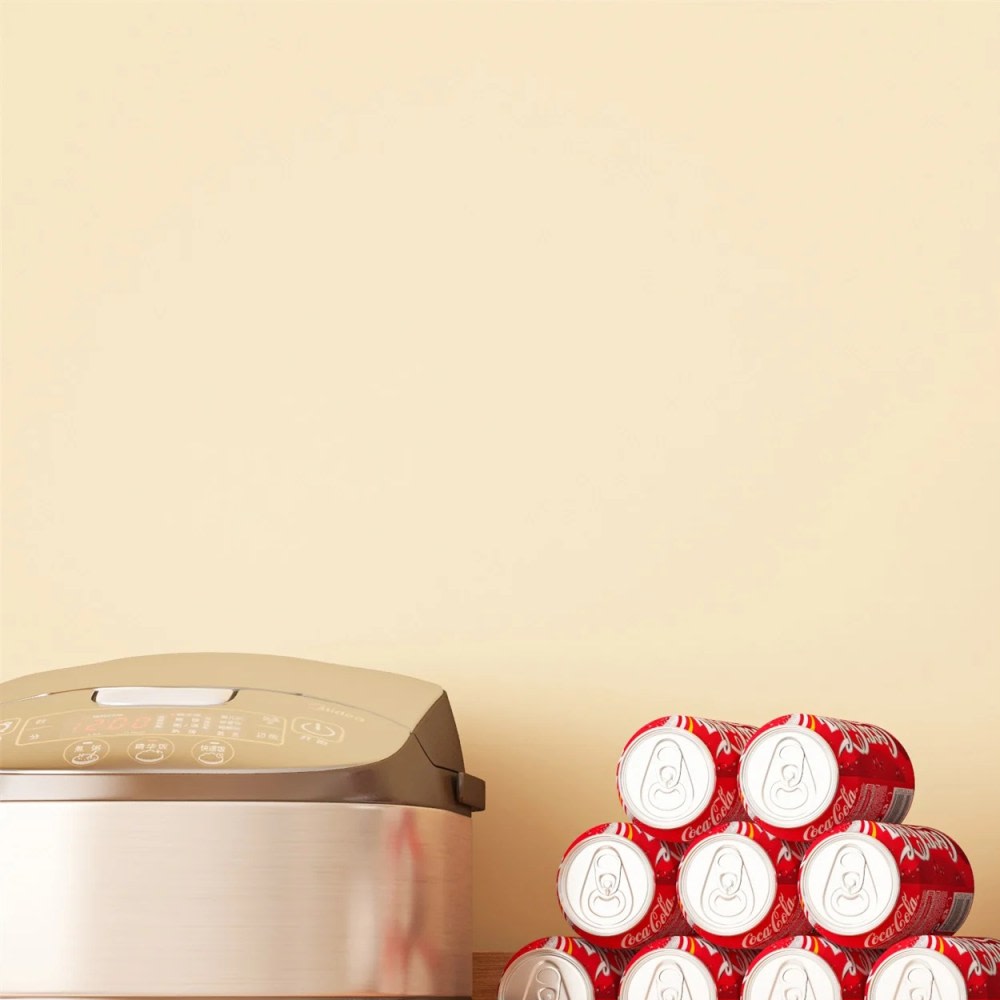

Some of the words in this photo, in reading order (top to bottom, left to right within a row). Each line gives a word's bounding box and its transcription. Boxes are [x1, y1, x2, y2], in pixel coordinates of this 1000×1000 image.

[681, 788, 736, 842] Coca-Cola
[803, 786, 858, 842] Coca-Cola
[620, 894, 675, 948] Coca-Cola
[741, 894, 796, 948] Coca-Cola
[864, 894, 920, 949] Coca-Cola
